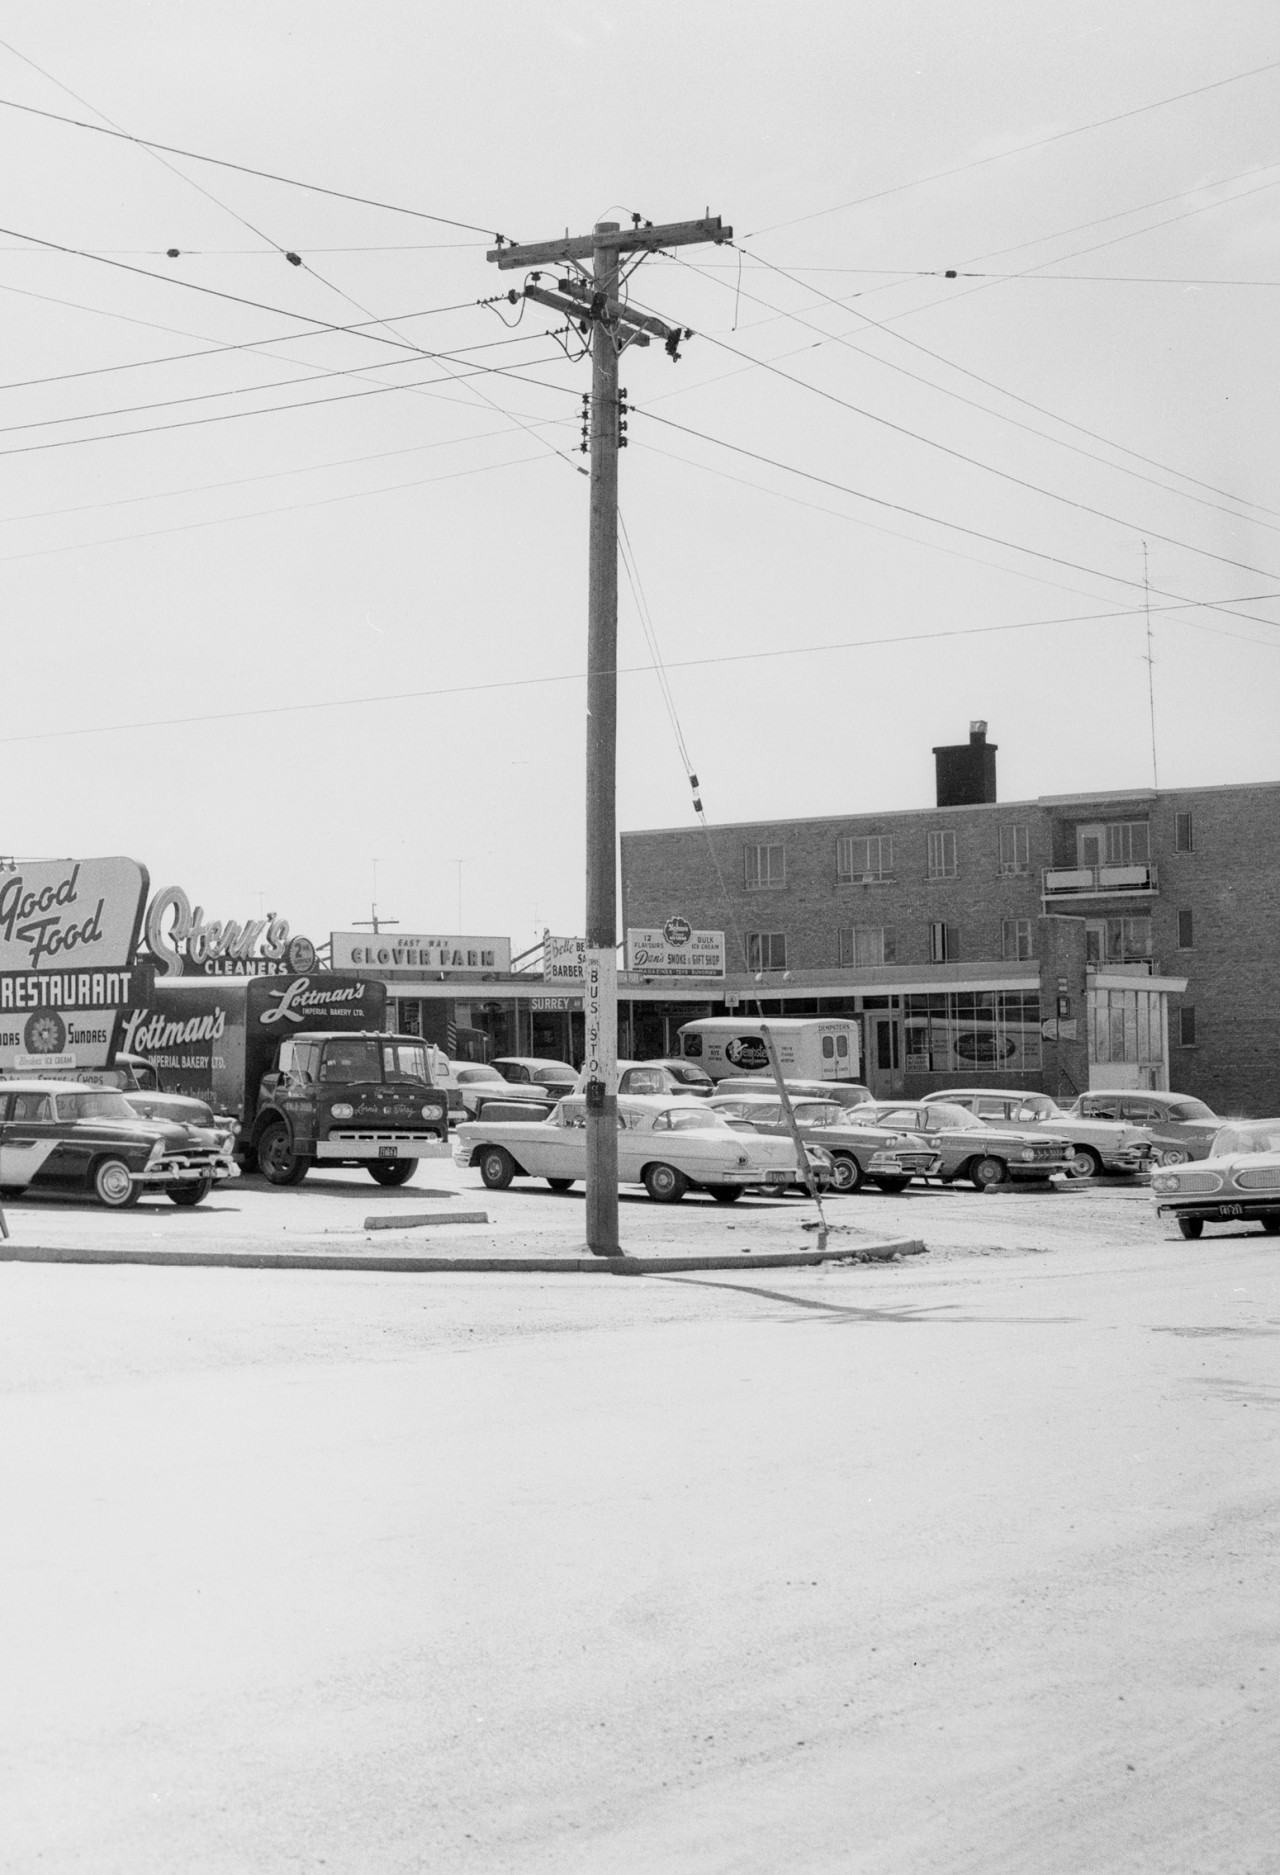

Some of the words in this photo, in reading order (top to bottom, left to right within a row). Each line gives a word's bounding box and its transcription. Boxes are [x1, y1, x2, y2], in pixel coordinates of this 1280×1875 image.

[15, 897, 105, 970] Food
[397, 938, 421, 947] EAST
[634, 941, 664, 949] FLAVOURS
[351, 947, 432, 966] CLOVER
[440, 950, 495, 967] FARM
[633, 949, 665, 966] Dan's
[667, 953, 687, 965] SMOKE
[692, 954, 705, 965] GIFT
[705, 954, 720, 966] SHOP
[204, 959, 289, 976] CLEANERS
[552, 964, 584, 978] BARBER
[1, 972, 132, 1008] RESTAURANT
[590, 969, 599, 1014] BUS
[260, 977, 366, 1024] Lottman's
[531, 998, 570, 1010] SURREY
[302, 1007, 328, 1016] IMPERIAL
[329, 1008, 352, 1017] BAKERY
[54, 1055, 73, 1064] CREAM
[181, 1056, 210, 1069] BAKERY
